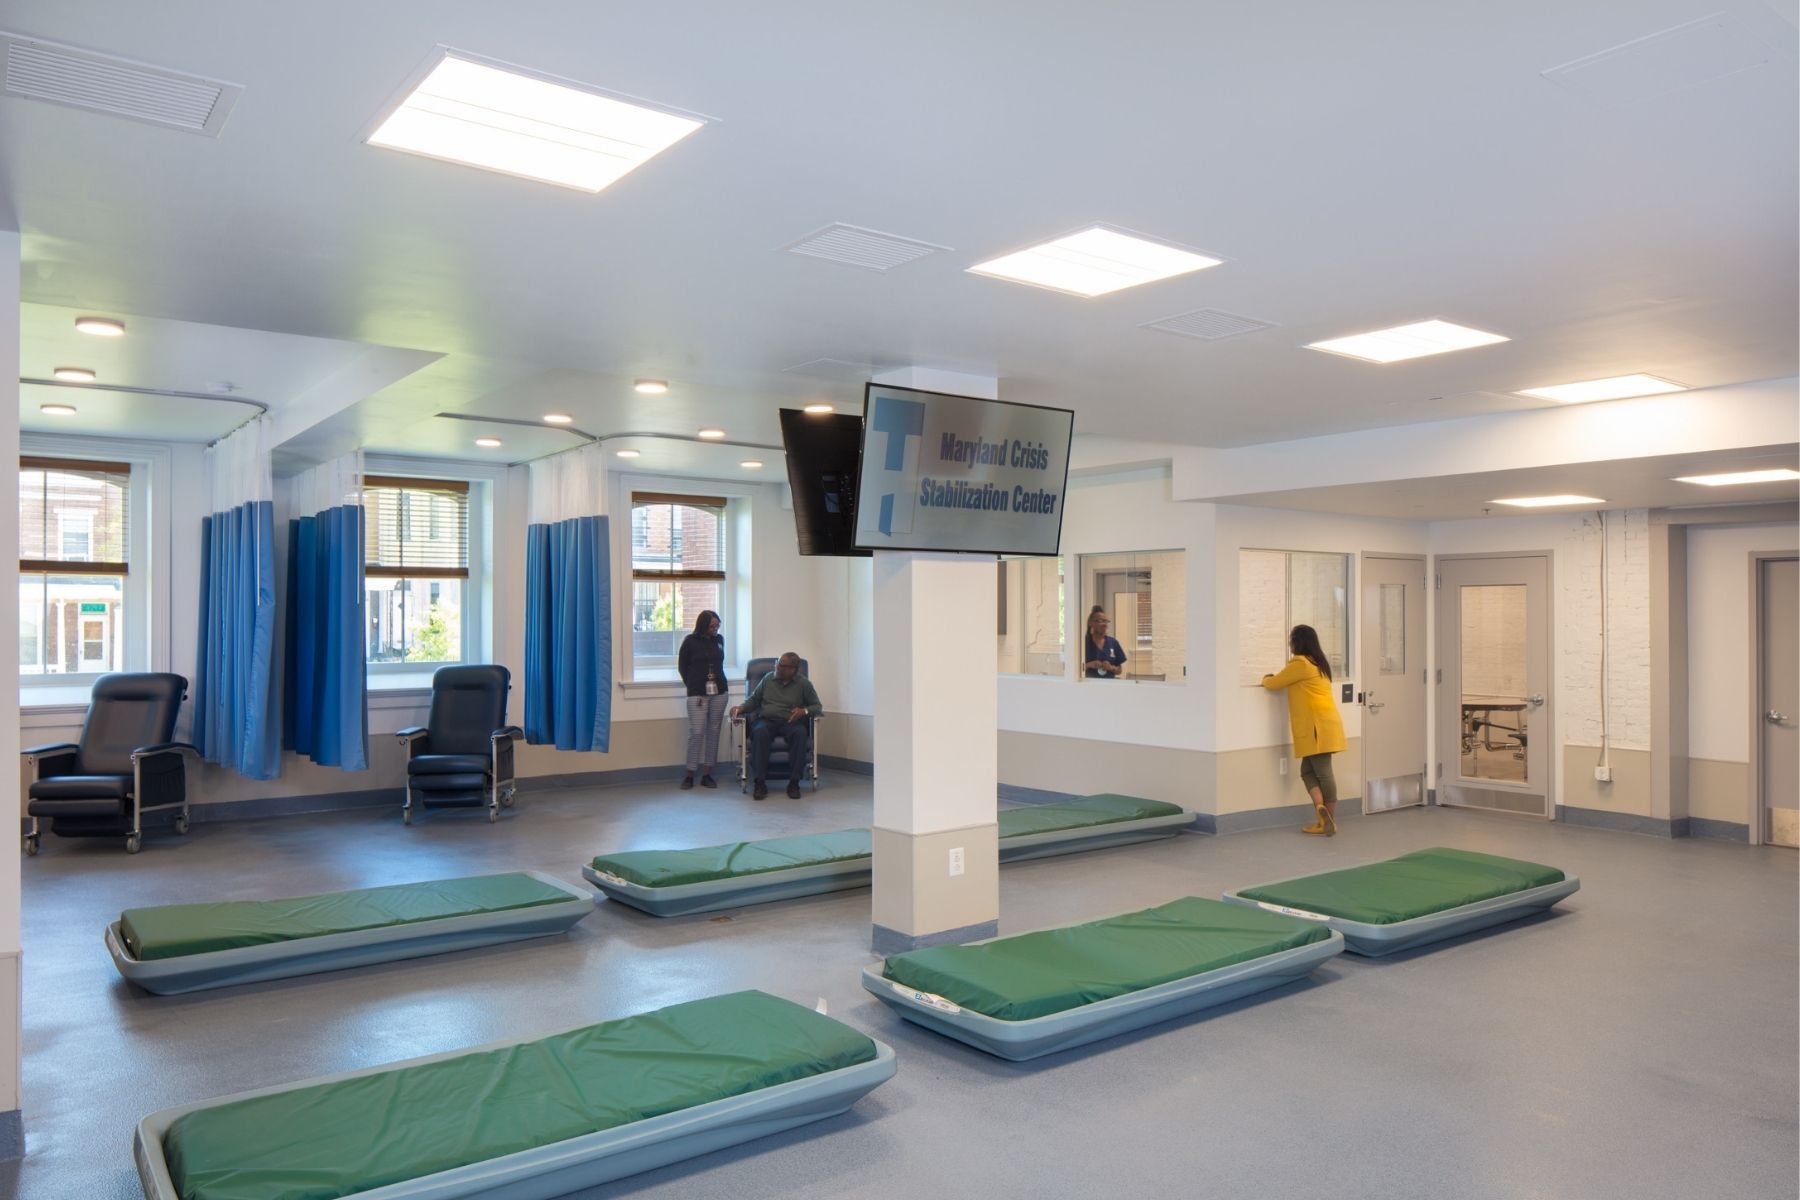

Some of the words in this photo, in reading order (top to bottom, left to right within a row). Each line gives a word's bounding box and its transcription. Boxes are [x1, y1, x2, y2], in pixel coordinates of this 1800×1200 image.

[939, 432, 1009, 470] Maryland
[1010, 439, 1049, 471] Crisis
[919, 477, 1009, 512] Stabilization
[1012, 485, 1057, 515] Center
